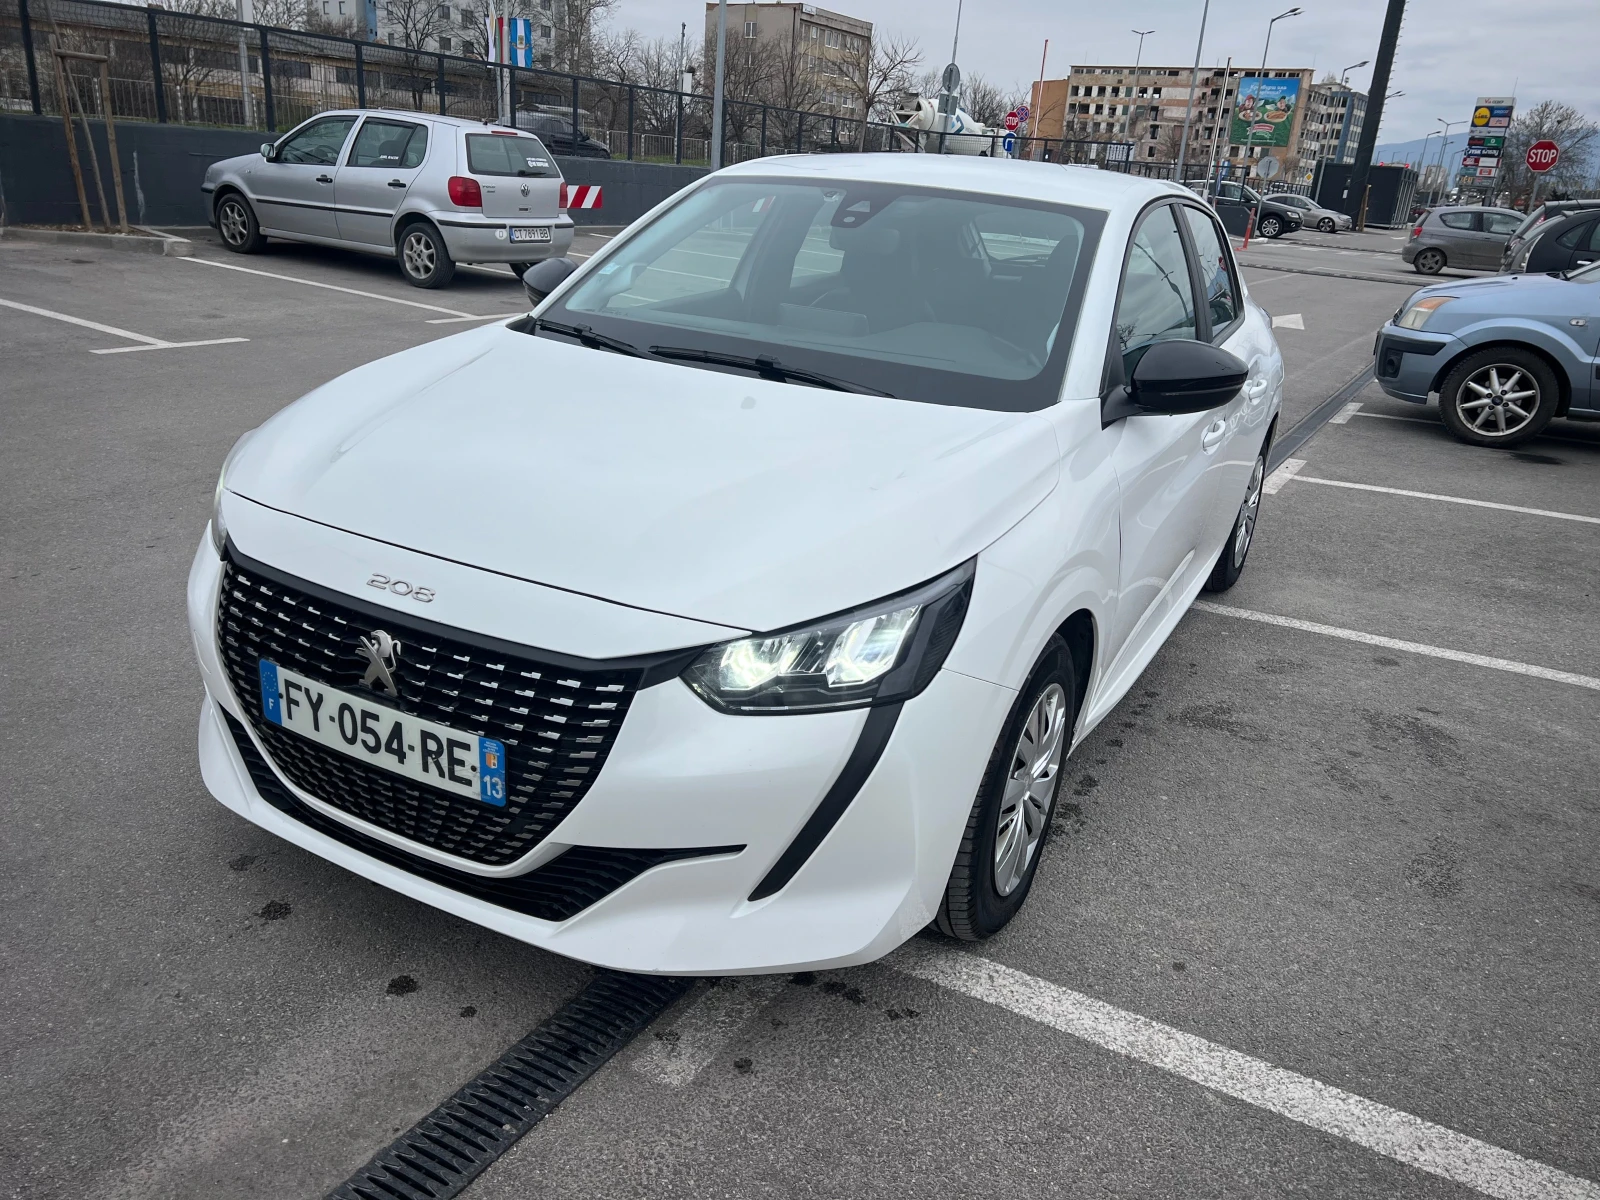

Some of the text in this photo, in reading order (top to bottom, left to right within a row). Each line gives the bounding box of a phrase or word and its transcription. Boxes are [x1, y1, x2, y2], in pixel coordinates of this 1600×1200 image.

[1006, 117, 1018, 126] STOP
[1528, 149, 1557, 163] STOP
[366, 572, 436, 603] 208
[268, 697, 275, 710] F
[483, 774, 503, 799] 13
